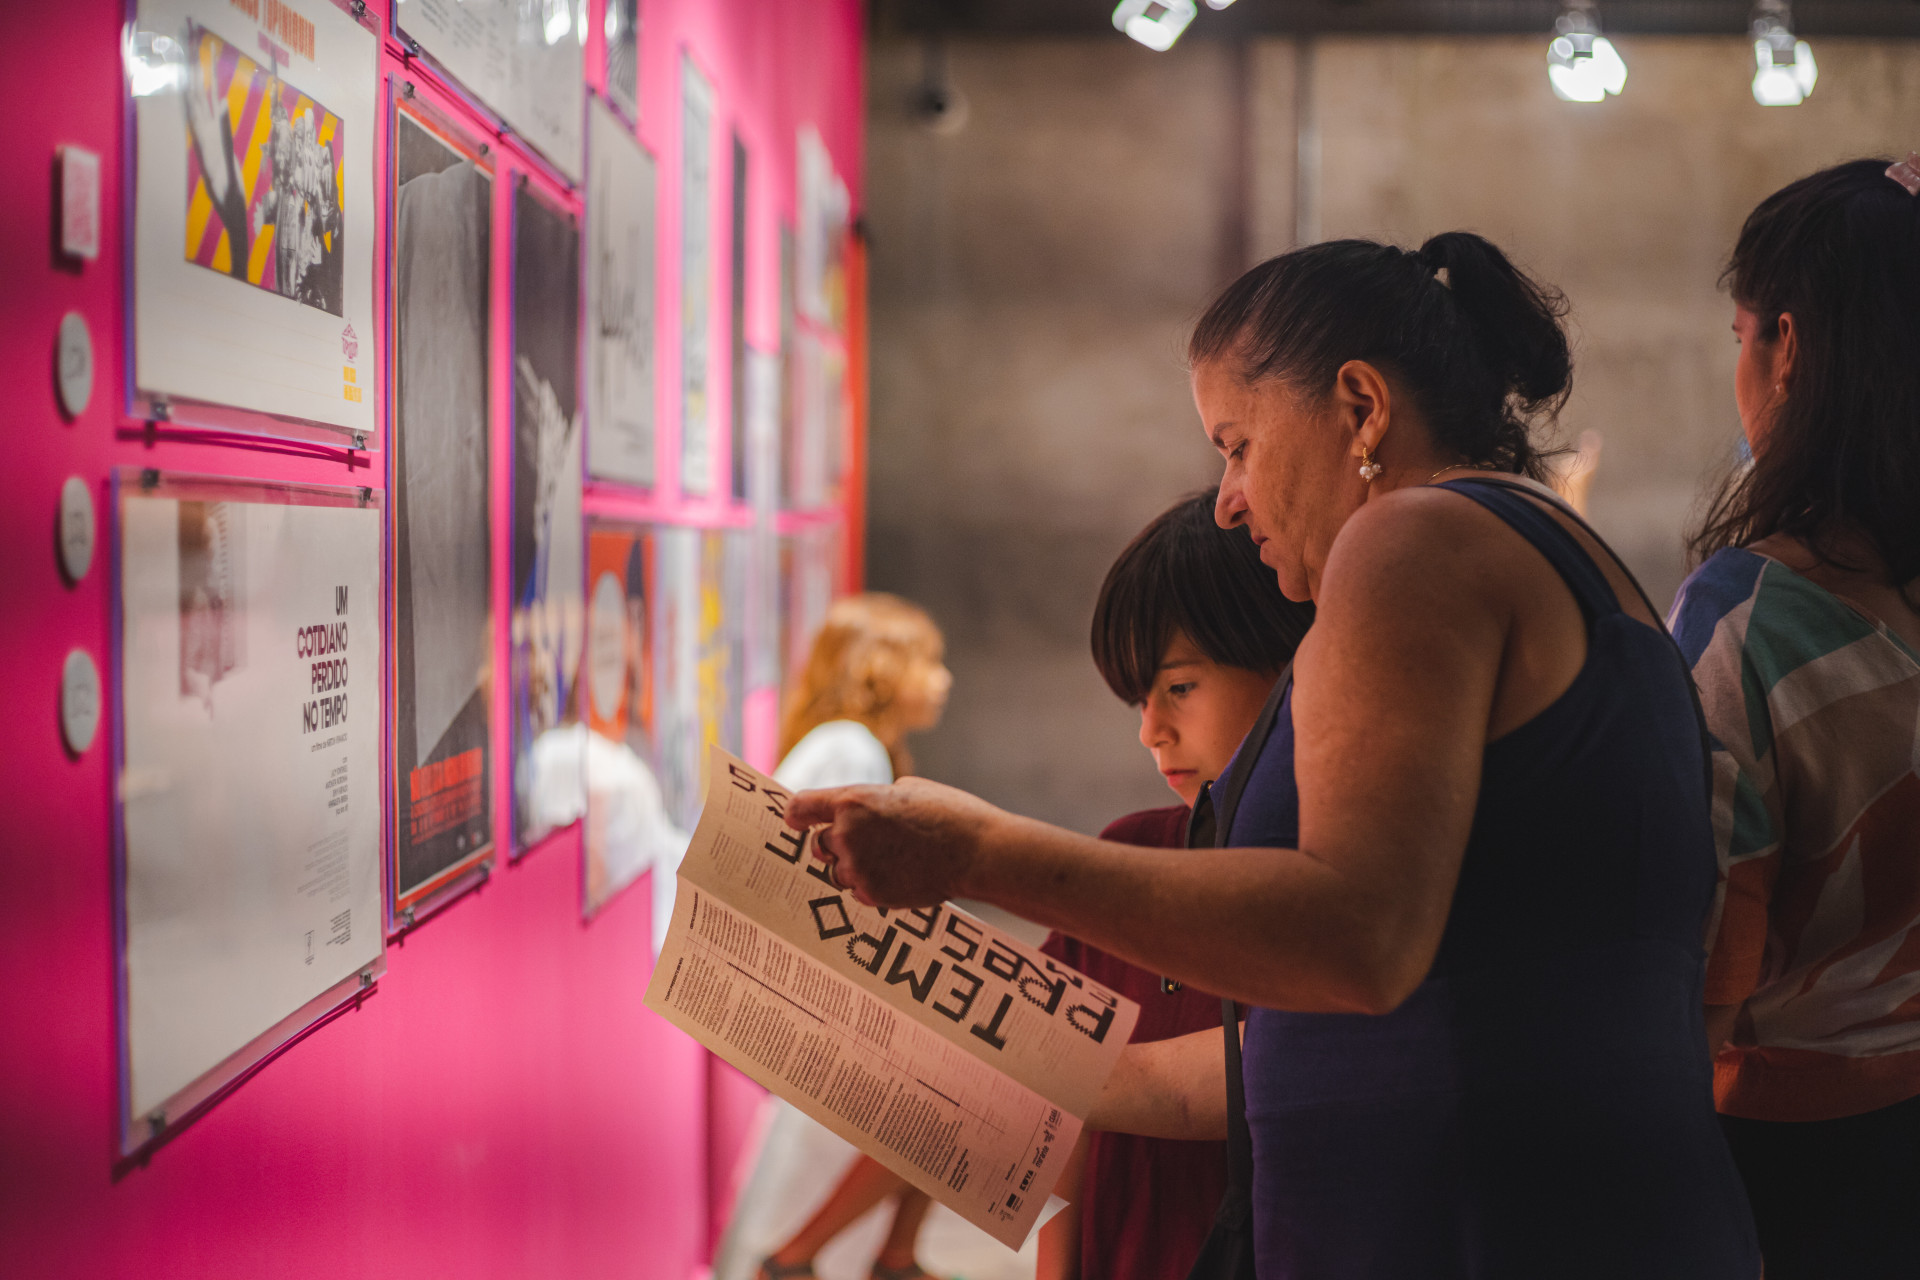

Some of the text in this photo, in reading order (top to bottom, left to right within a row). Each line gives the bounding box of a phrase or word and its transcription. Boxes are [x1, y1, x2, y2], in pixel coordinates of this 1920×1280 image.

[335, 585, 348, 616] UM
[297, 621, 348, 659] COTIDIANO
[311, 656, 348, 695] PERDIDO
[303, 694, 348, 735] NO TEMPO
[808, 894, 1012, 1051] TEMPO
